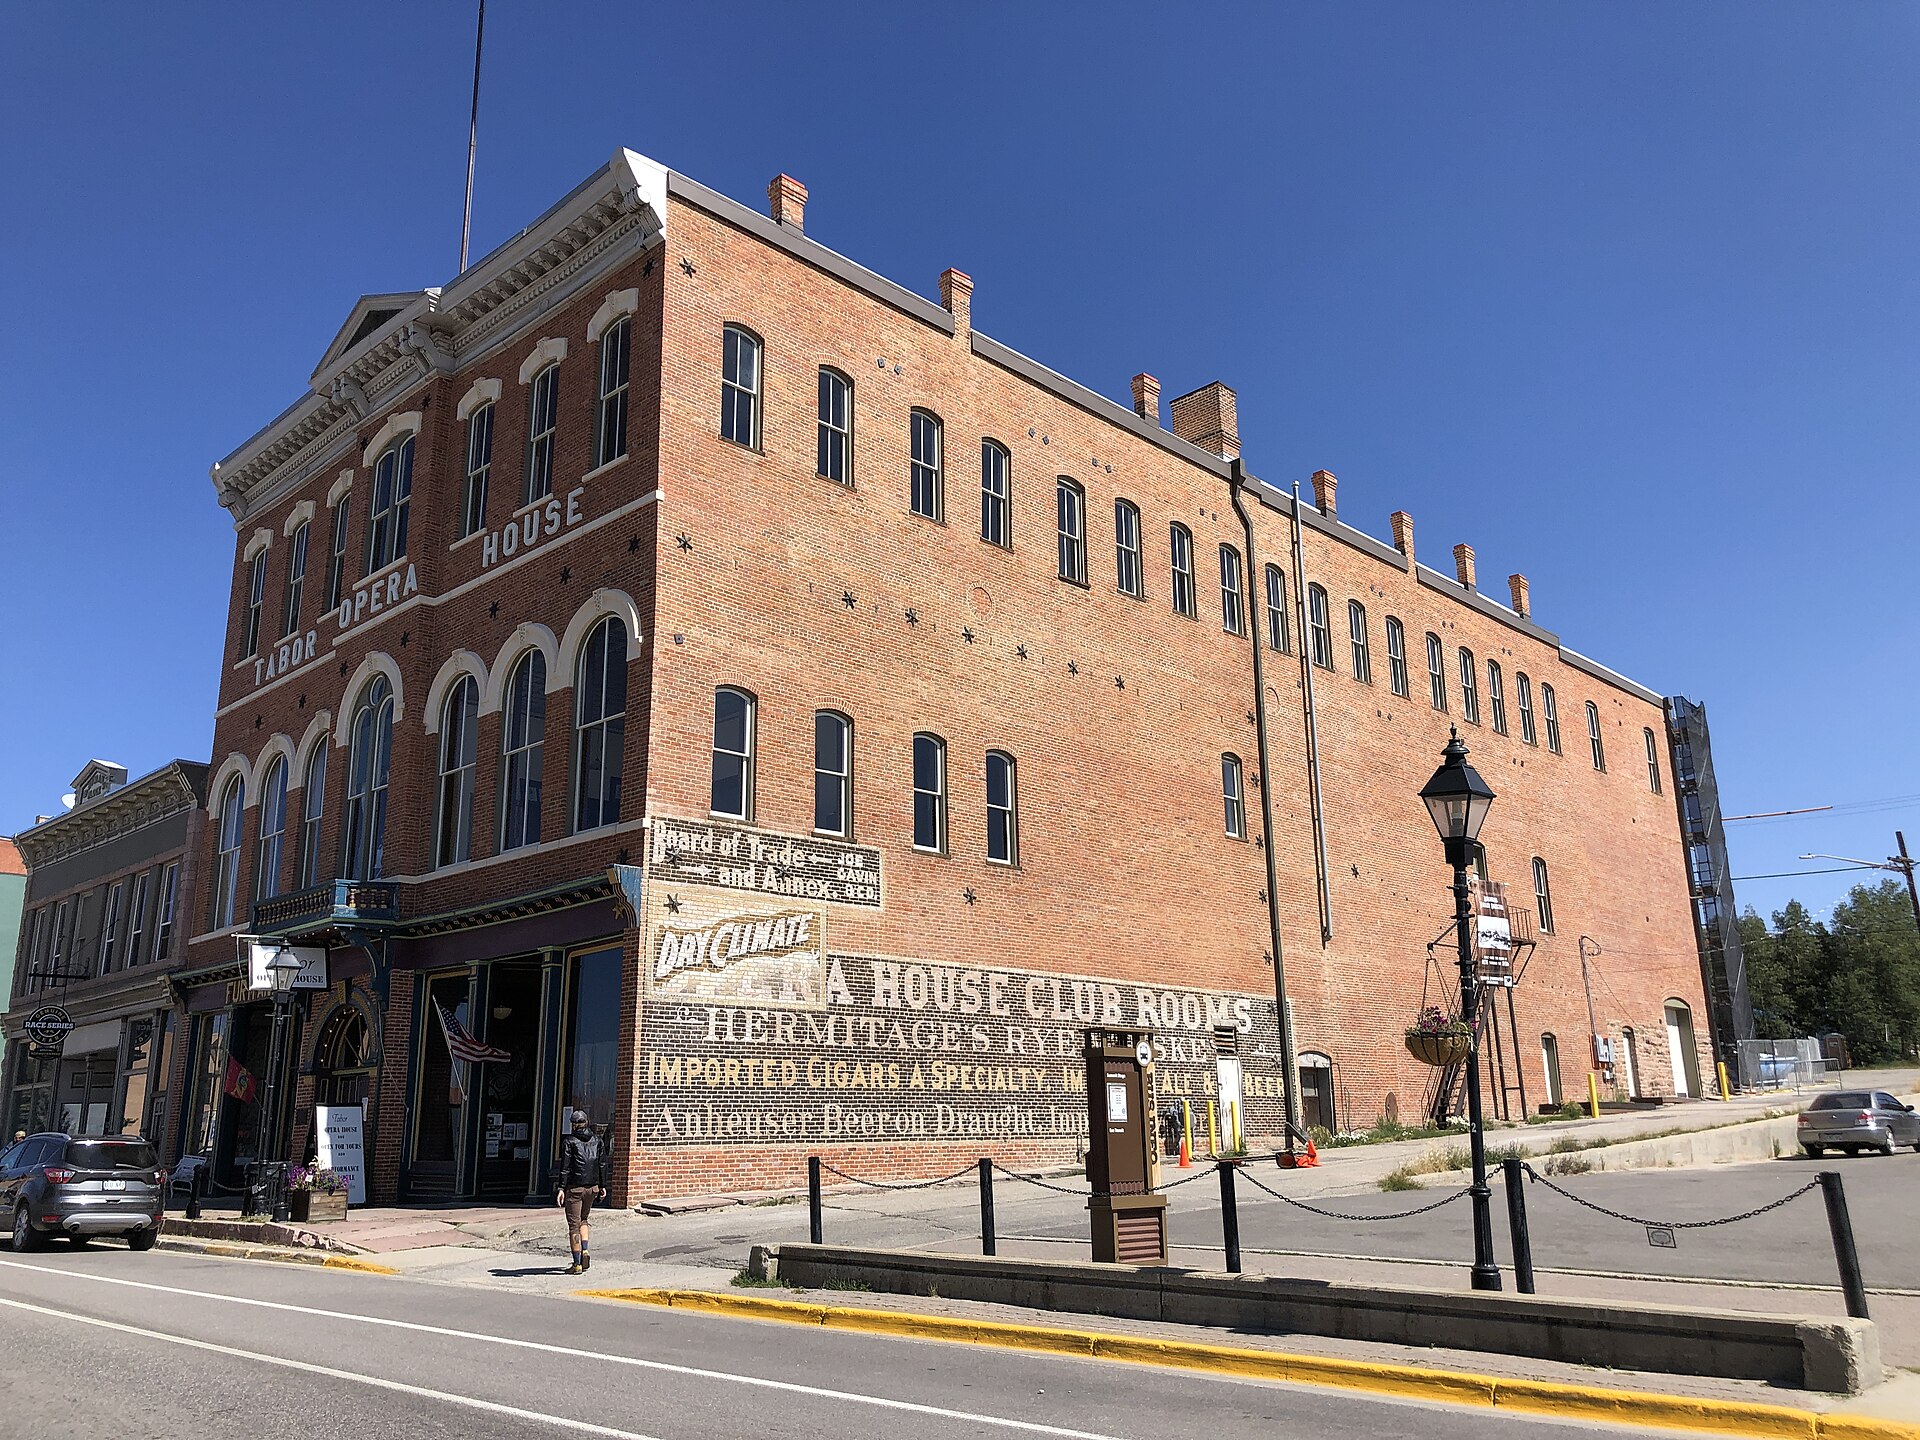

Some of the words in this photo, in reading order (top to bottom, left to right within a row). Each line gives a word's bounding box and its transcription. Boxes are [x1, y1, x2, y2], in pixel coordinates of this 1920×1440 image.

[255, 630, 318, 686] TABOR
[338, 563, 418, 629] OPERA
[482, 487, 585, 568] HOUSE
[653, 821, 713, 863] Board
[720, 831, 743, 855] of
[749, 836, 806, 866] Trade
[718, 864, 755, 887] and
[709, 912, 814, 968] CLIMATE
[295, 974, 324, 984] HOUSE
[873, 962, 1010, 1016] HOUSE
[1025, 977, 1122, 1024] CLUB
[1136, 988, 1252, 1034] ROOMS
[25, 1021, 47, 1029] RACE
[35, 1008, 67, 1020] GENUINE
[1004, 1026, 1079, 1057] RYE
[647, 1051, 796, 1086] IMPORTED
[807, 1056, 899, 1088] CIGARS
[909, 1065, 924, 1090] A
[1161, 1070, 1192, 1095] ALE
[1202, 1071, 1215, 1095] &
[1146, 1072, 1155, 1112] BUS
[650, 1104, 816, 1138] Anheuser
[824, 1104, 893, 1136] Beer
[895, 1111, 928, 1136] on
[1149, 1116, 1158, 1165] INFO
